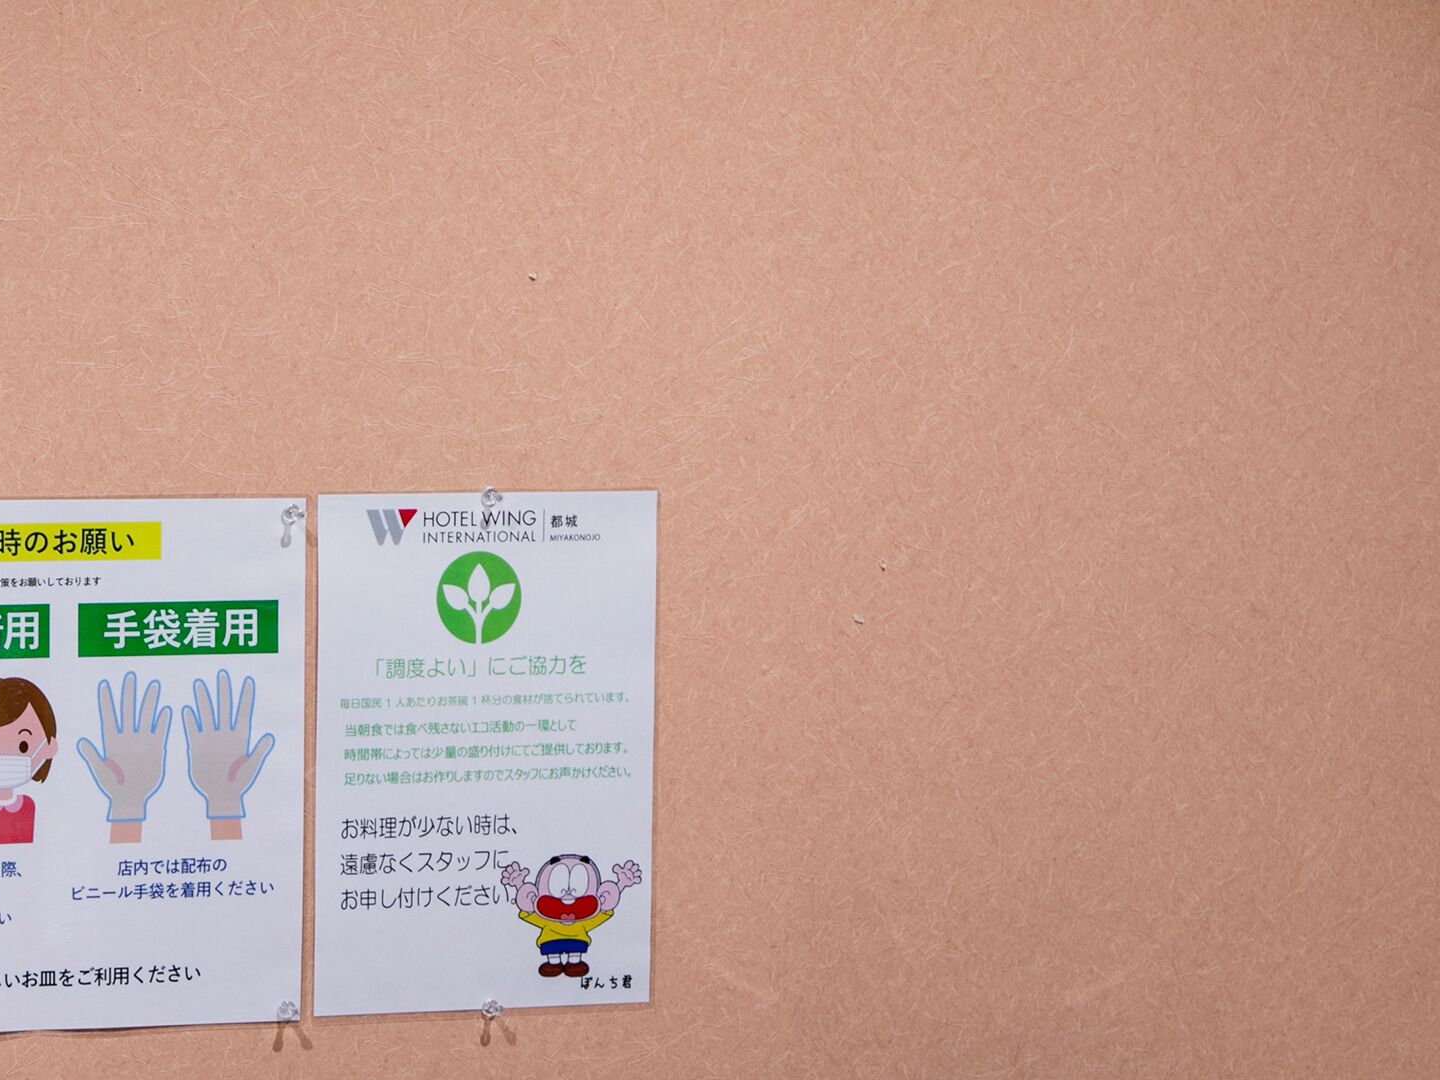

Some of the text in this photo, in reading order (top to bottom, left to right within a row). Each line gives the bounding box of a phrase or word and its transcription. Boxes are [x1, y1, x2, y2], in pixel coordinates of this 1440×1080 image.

[423, 509, 537, 527] HOTEL WING
[550, 514, 578, 528] 都城
[423, 530, 537, 544] INTERNATIONAL
[549, 533, 601, 542] MIYAKONOJO
[103, 607, 260, 650] 手袋着用
[375, 654, 588, 680] 「調度よい」にご協力を
[345, 719, 577, 738] 当朝食では食べ残さないエコ活動の一環として
[343, 741, 629, 762] 時間帯によっては少量の盛り付けにてご提供しております。
[343, 765, 633, 787] 足りない場合はお作りしますのでスタッフにお声かけください。
[340, 813, 519, 840] お料理が少ない時は、
[117, 857, 228, 877] 店内では配布の
[340, 849, 510, 876] 遠慮なくスタッフに
[70, 880, 275, 901] ビニール手袋を着用ください
[340, 884, 516, 911] お申し付けください。
